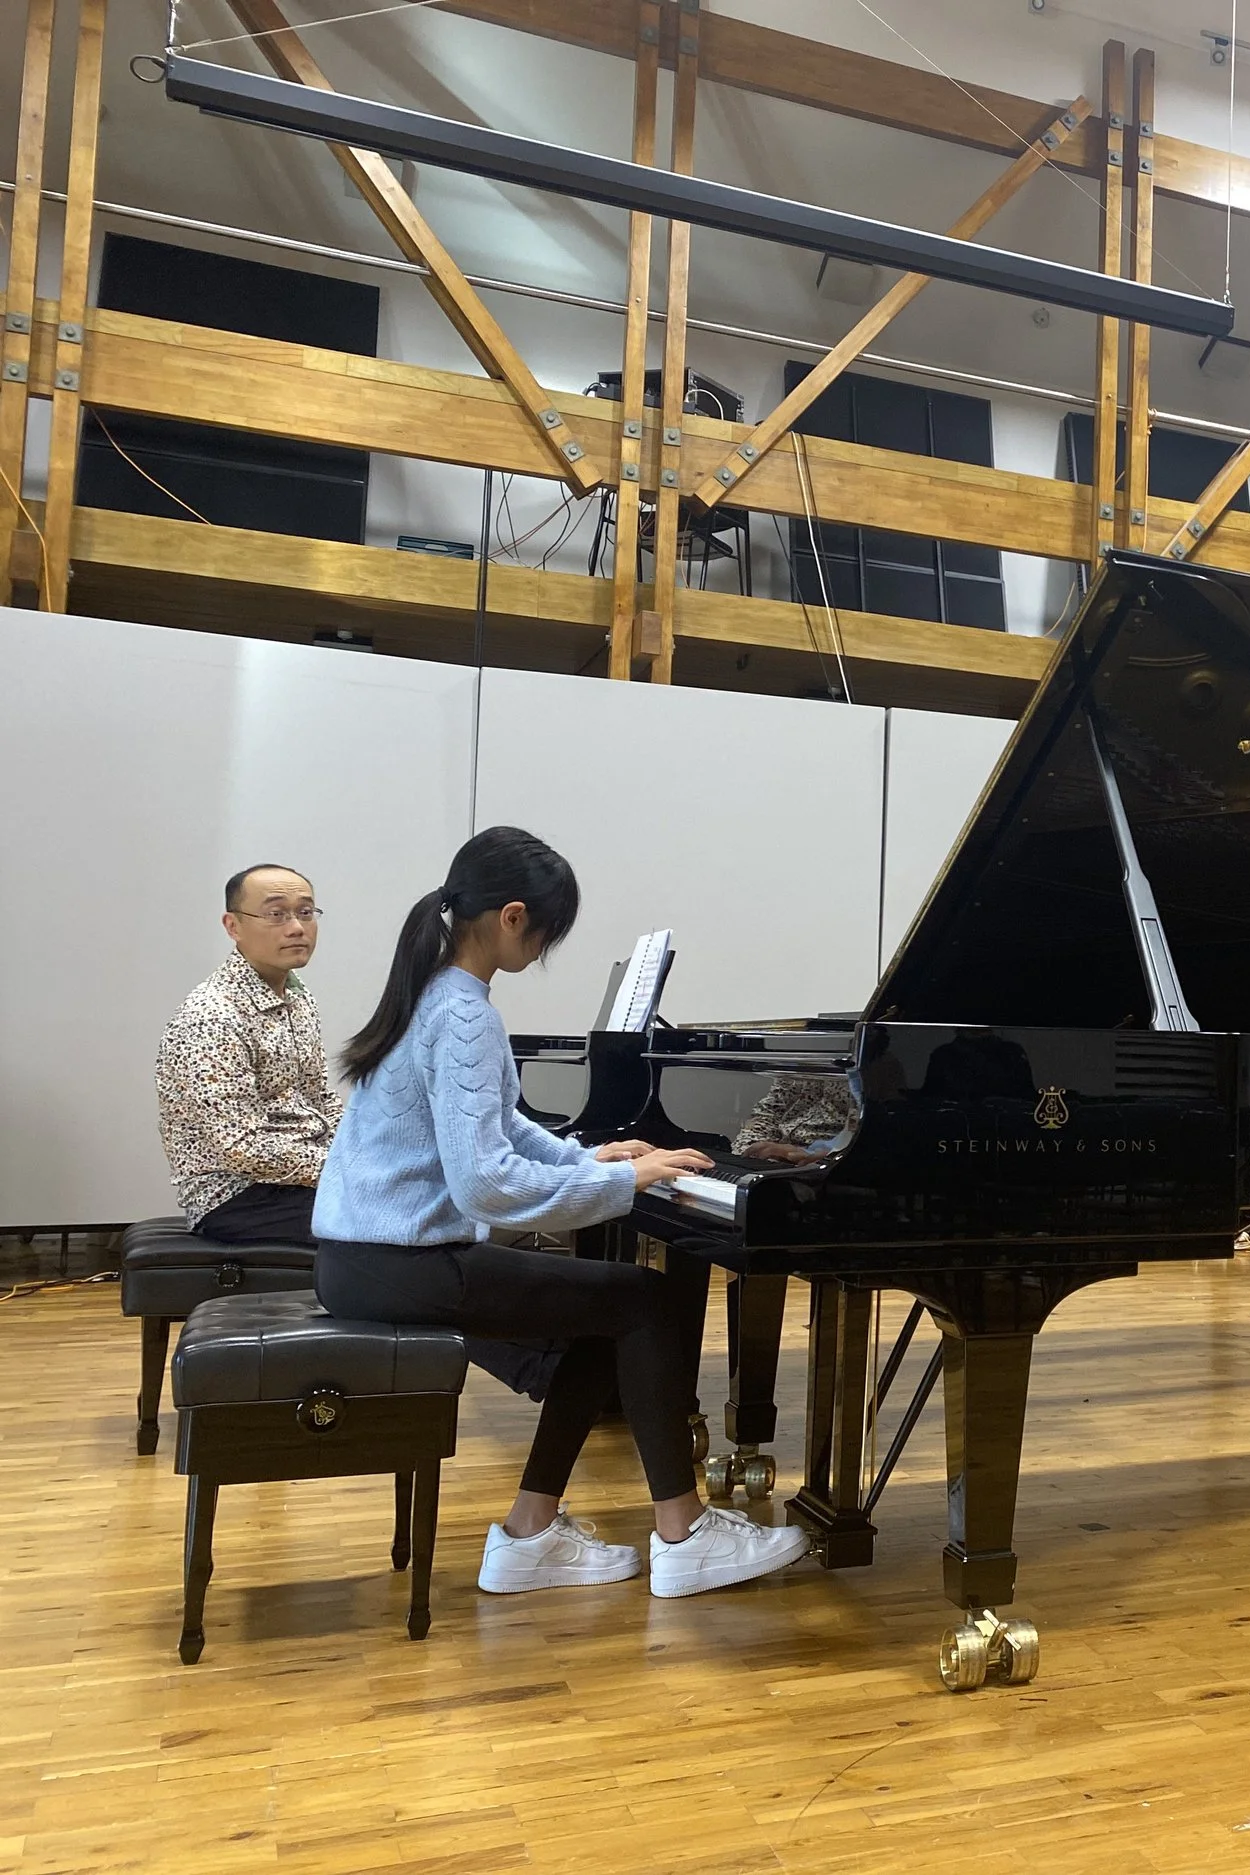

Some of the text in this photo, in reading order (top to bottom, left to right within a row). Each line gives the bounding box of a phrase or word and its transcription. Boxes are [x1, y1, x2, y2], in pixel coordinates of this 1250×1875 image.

[938, 1139, 1156, 1153] STEINWAY & SONS
